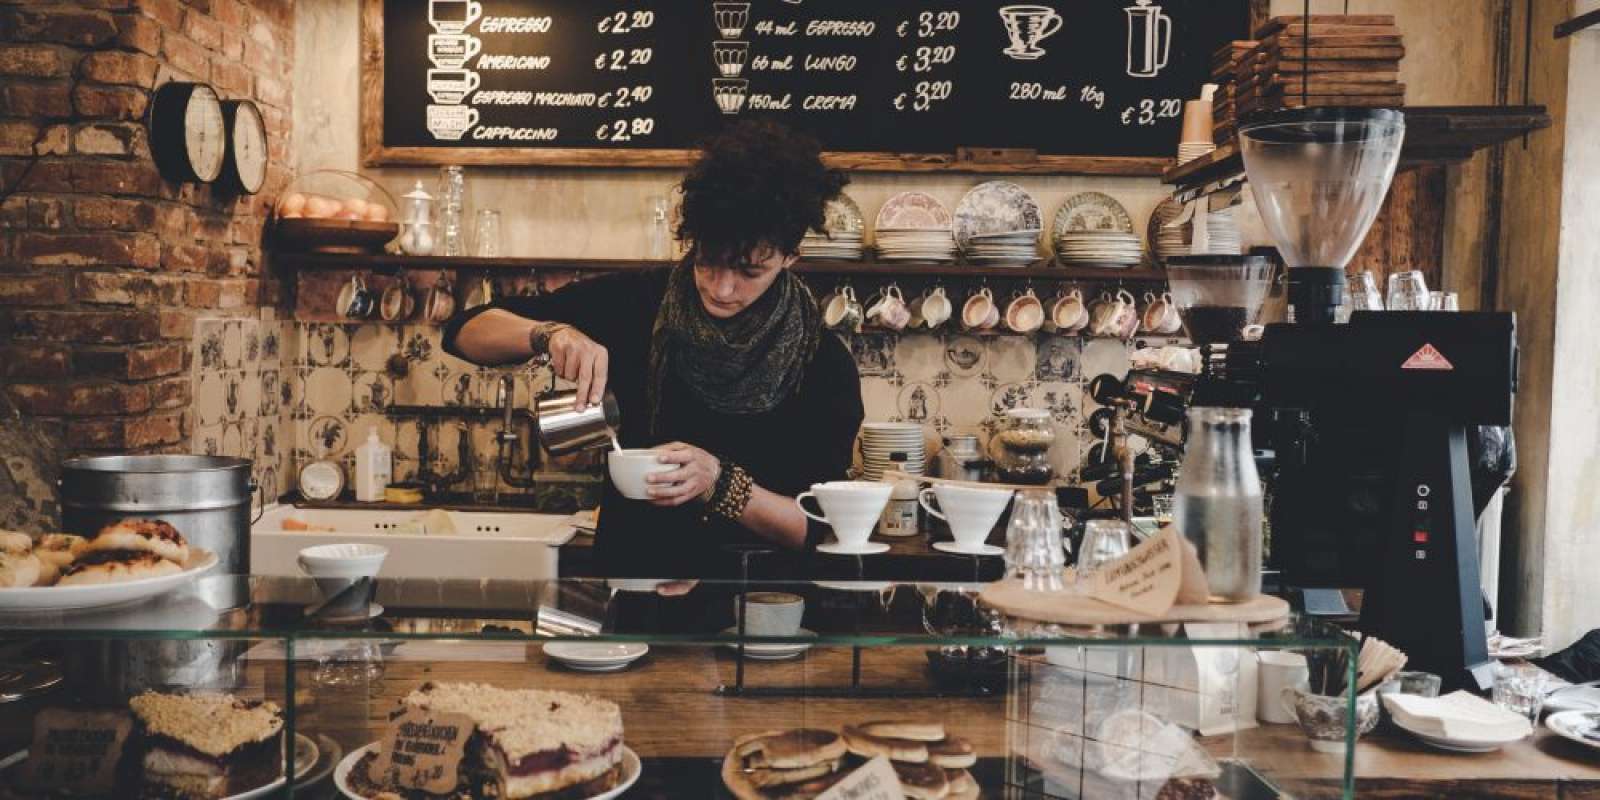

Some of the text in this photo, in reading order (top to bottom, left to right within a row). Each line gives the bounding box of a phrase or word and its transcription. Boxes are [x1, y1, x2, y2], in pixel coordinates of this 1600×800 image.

[479, 16, 552, 33] ESPRESSO
[612, 11, 654, 33] 2.20
[774, 21, 798, 36] ml
[805, 20, 876, 36] ESPRESSO
[896, 21, 909, 37] €
[918, 11, 960, 37] 3.20
[476, 48, 652, 70] AMERICANO € 2.20
[771, 55, 793, 71] ml
[804, 54, 857, 71] LUNGO
[896, 55, 908, 71] €
[914, 46, 956, 72] 3.20
[472, 86, 653, 108] ESPRESSO MACCHIATO € 2.40
[803, 94, 857, 110] CREMA
[893, 93, 906, 110] €
[914, 81, 953, 111] 3.20
[1009, 82, 1105, 109] 280 ml 16g
[1121, 99, 1181, 126] € 3.20
[473, 118, 654, 142] CAPPUCCINO € 2.80
